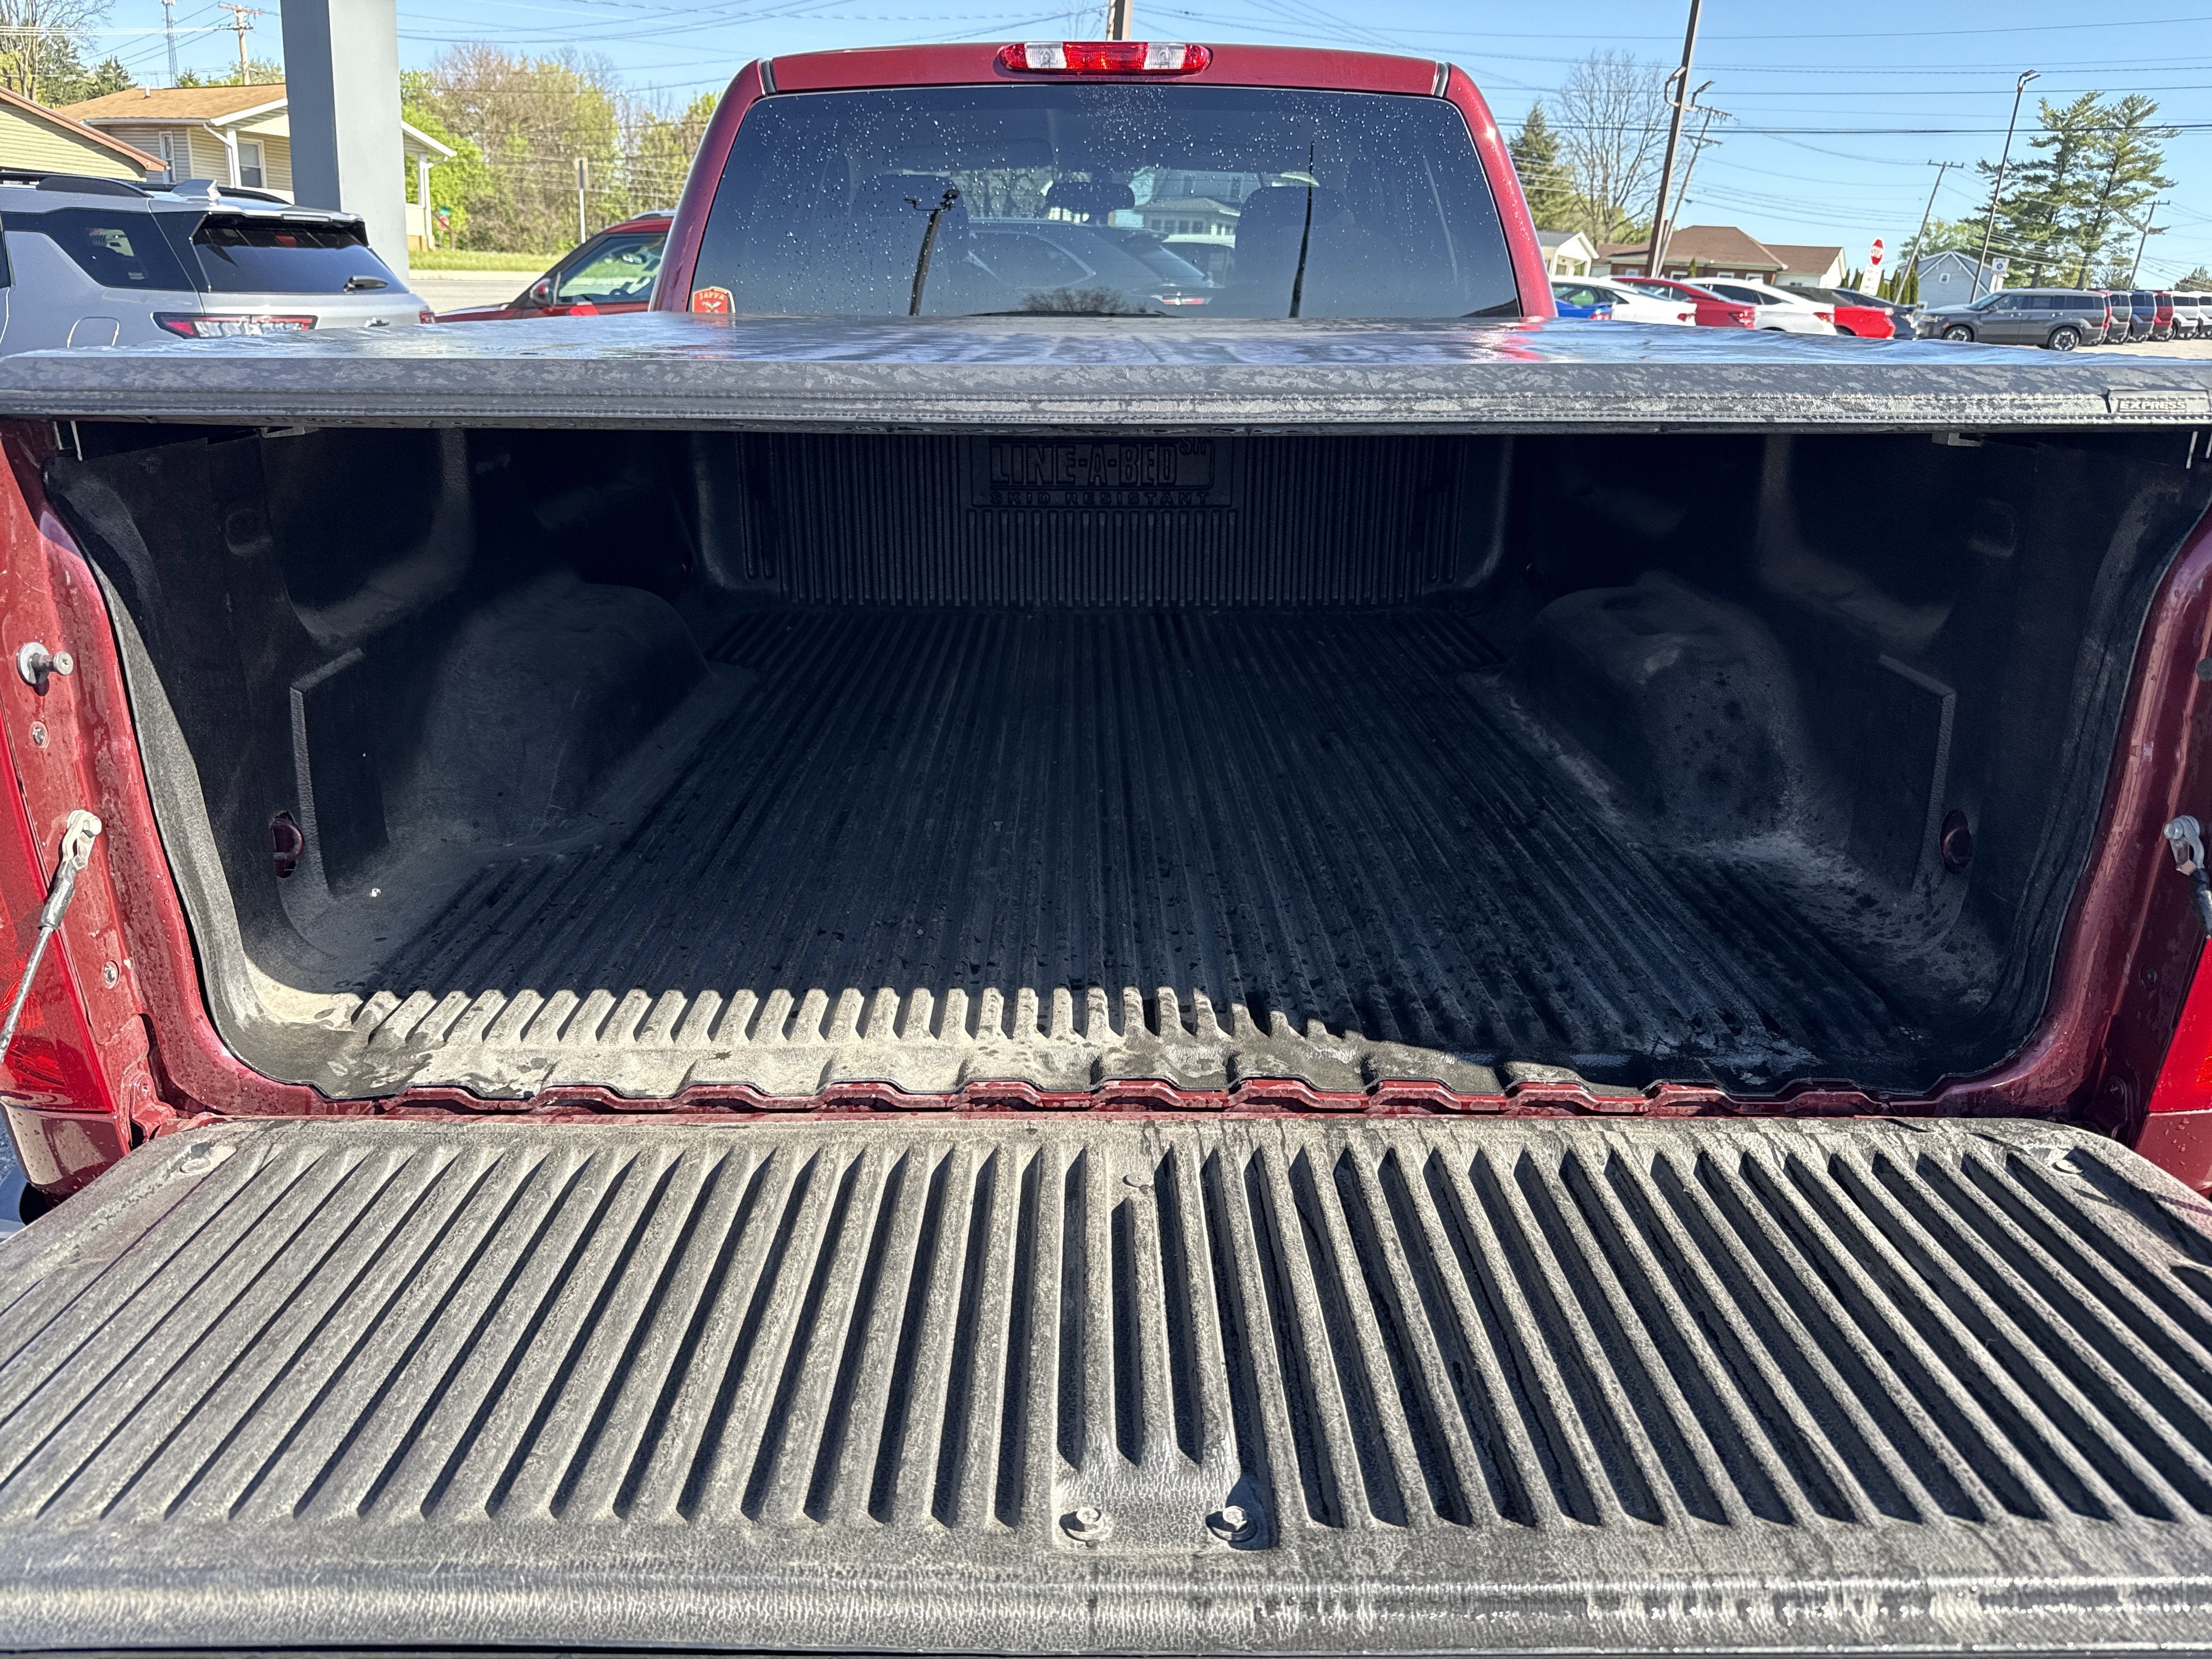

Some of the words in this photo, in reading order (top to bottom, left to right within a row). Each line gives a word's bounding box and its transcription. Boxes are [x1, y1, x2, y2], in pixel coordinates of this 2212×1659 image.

[1871, 245, 1884, 258] STOP
[2120, 400, 2186, 409] EXPRESS
[991, 443, 1177, 487] LINE-A-BED
[991, 491, 1051, 506] SKID
[1065, 491, 1209, 506] RESISTANT
